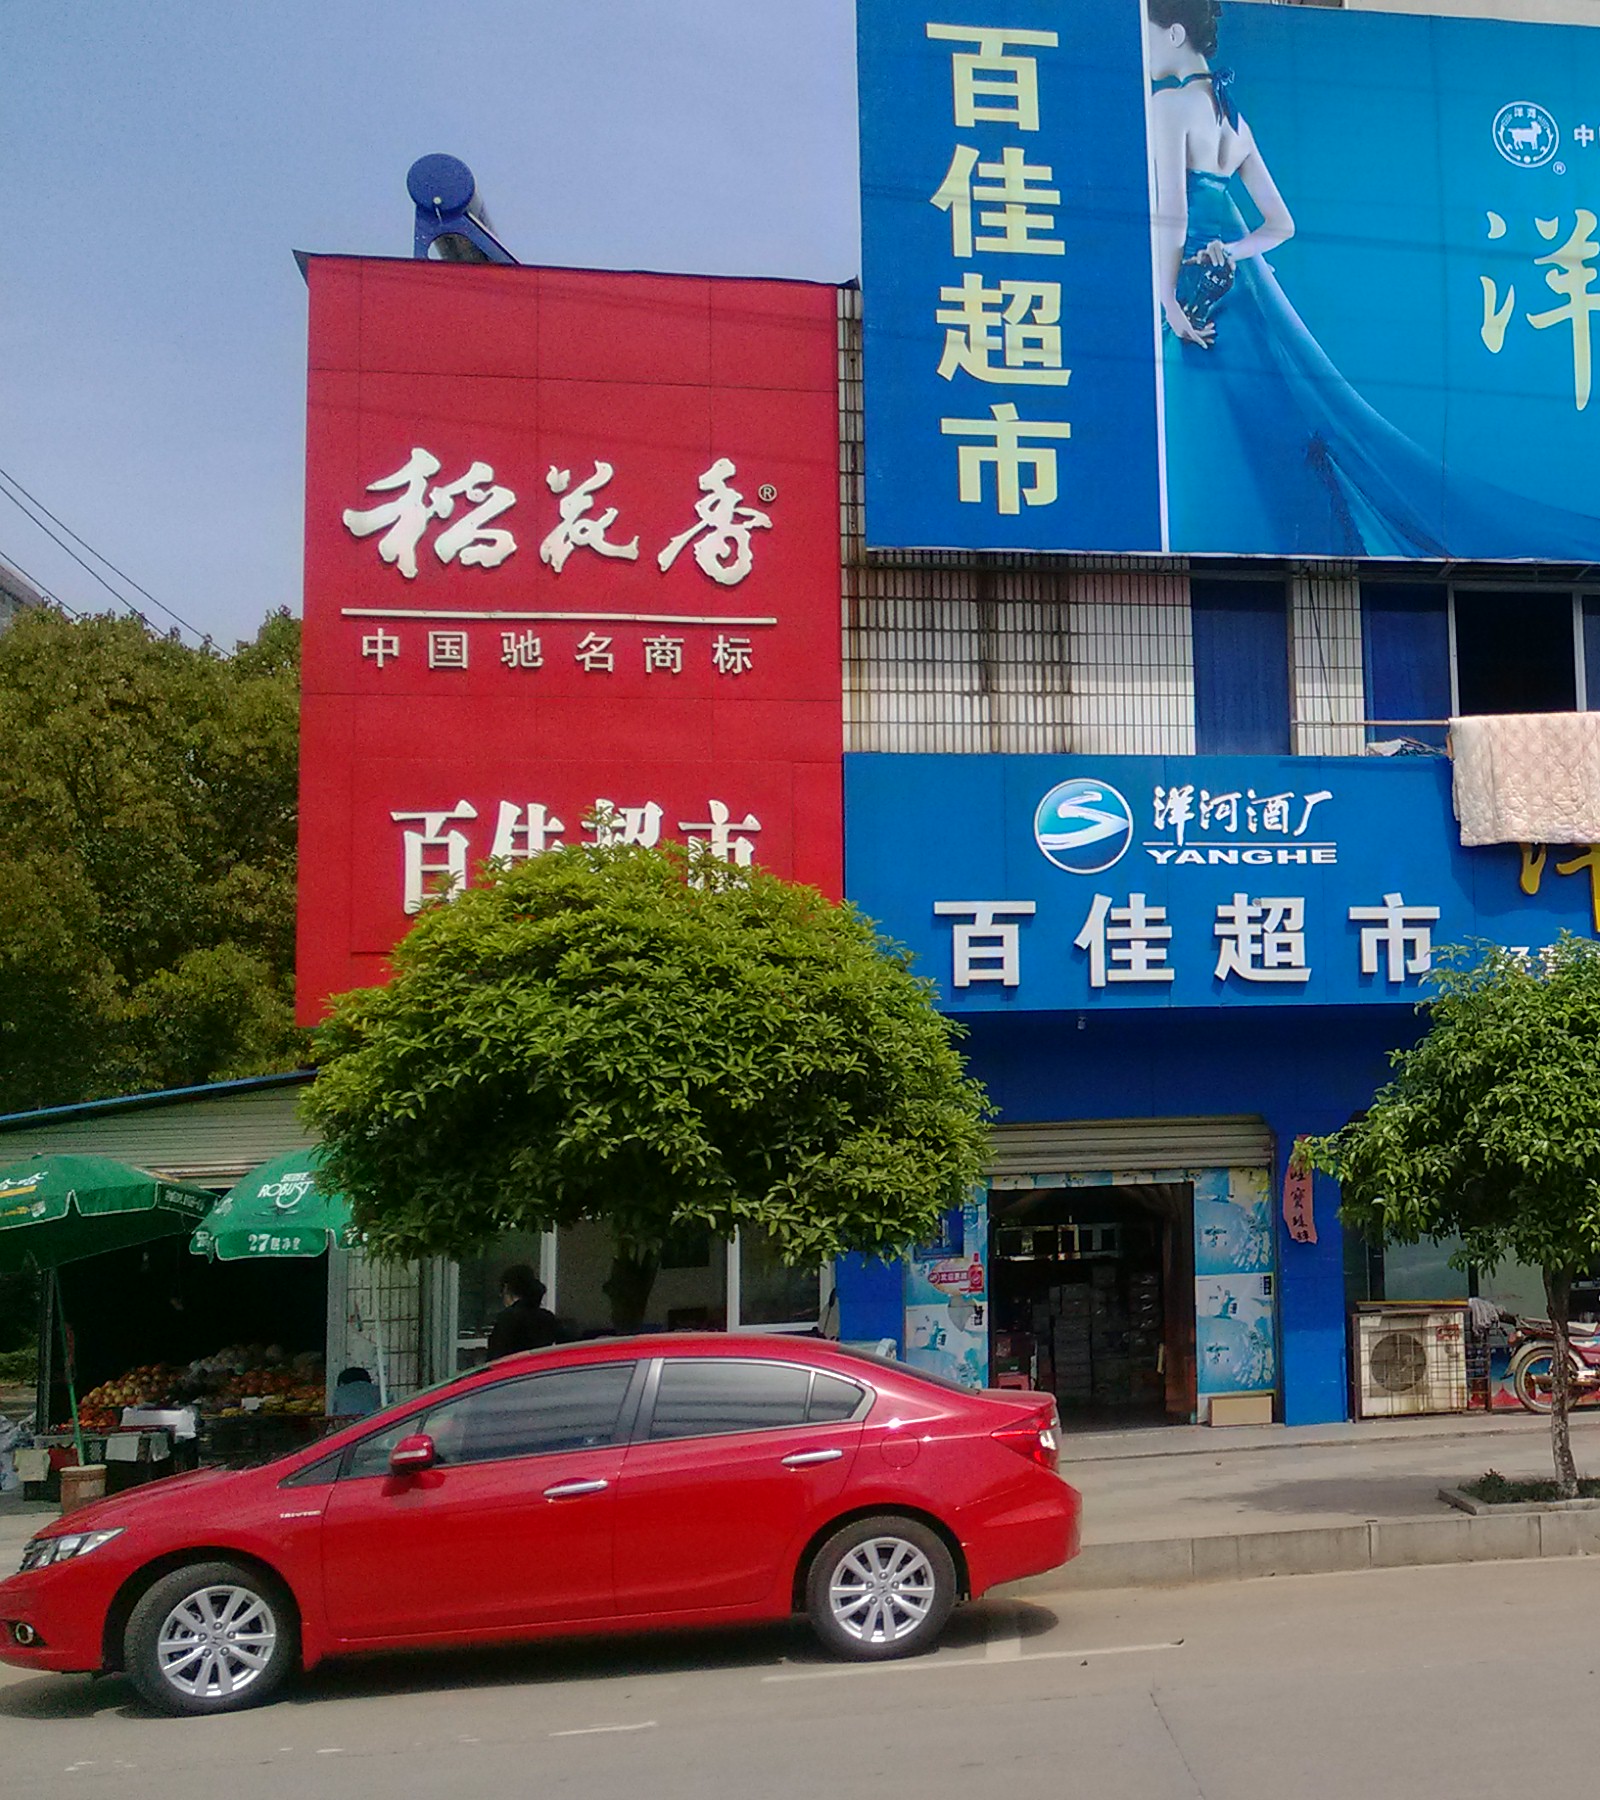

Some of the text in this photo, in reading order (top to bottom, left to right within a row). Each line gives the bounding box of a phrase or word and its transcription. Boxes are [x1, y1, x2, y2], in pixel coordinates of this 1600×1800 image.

[926, 22, 1072, 516] 百佳超市
[342, 447, 773, 586] 稻花香
[361, 629, 754, 675] 中国驰名商标
[1152, 785, 1334, 847] 洋河酒厂
[1146, 848, 1338, 866] YANGHE
[934, 892, 1441, 988] 百佳超市
